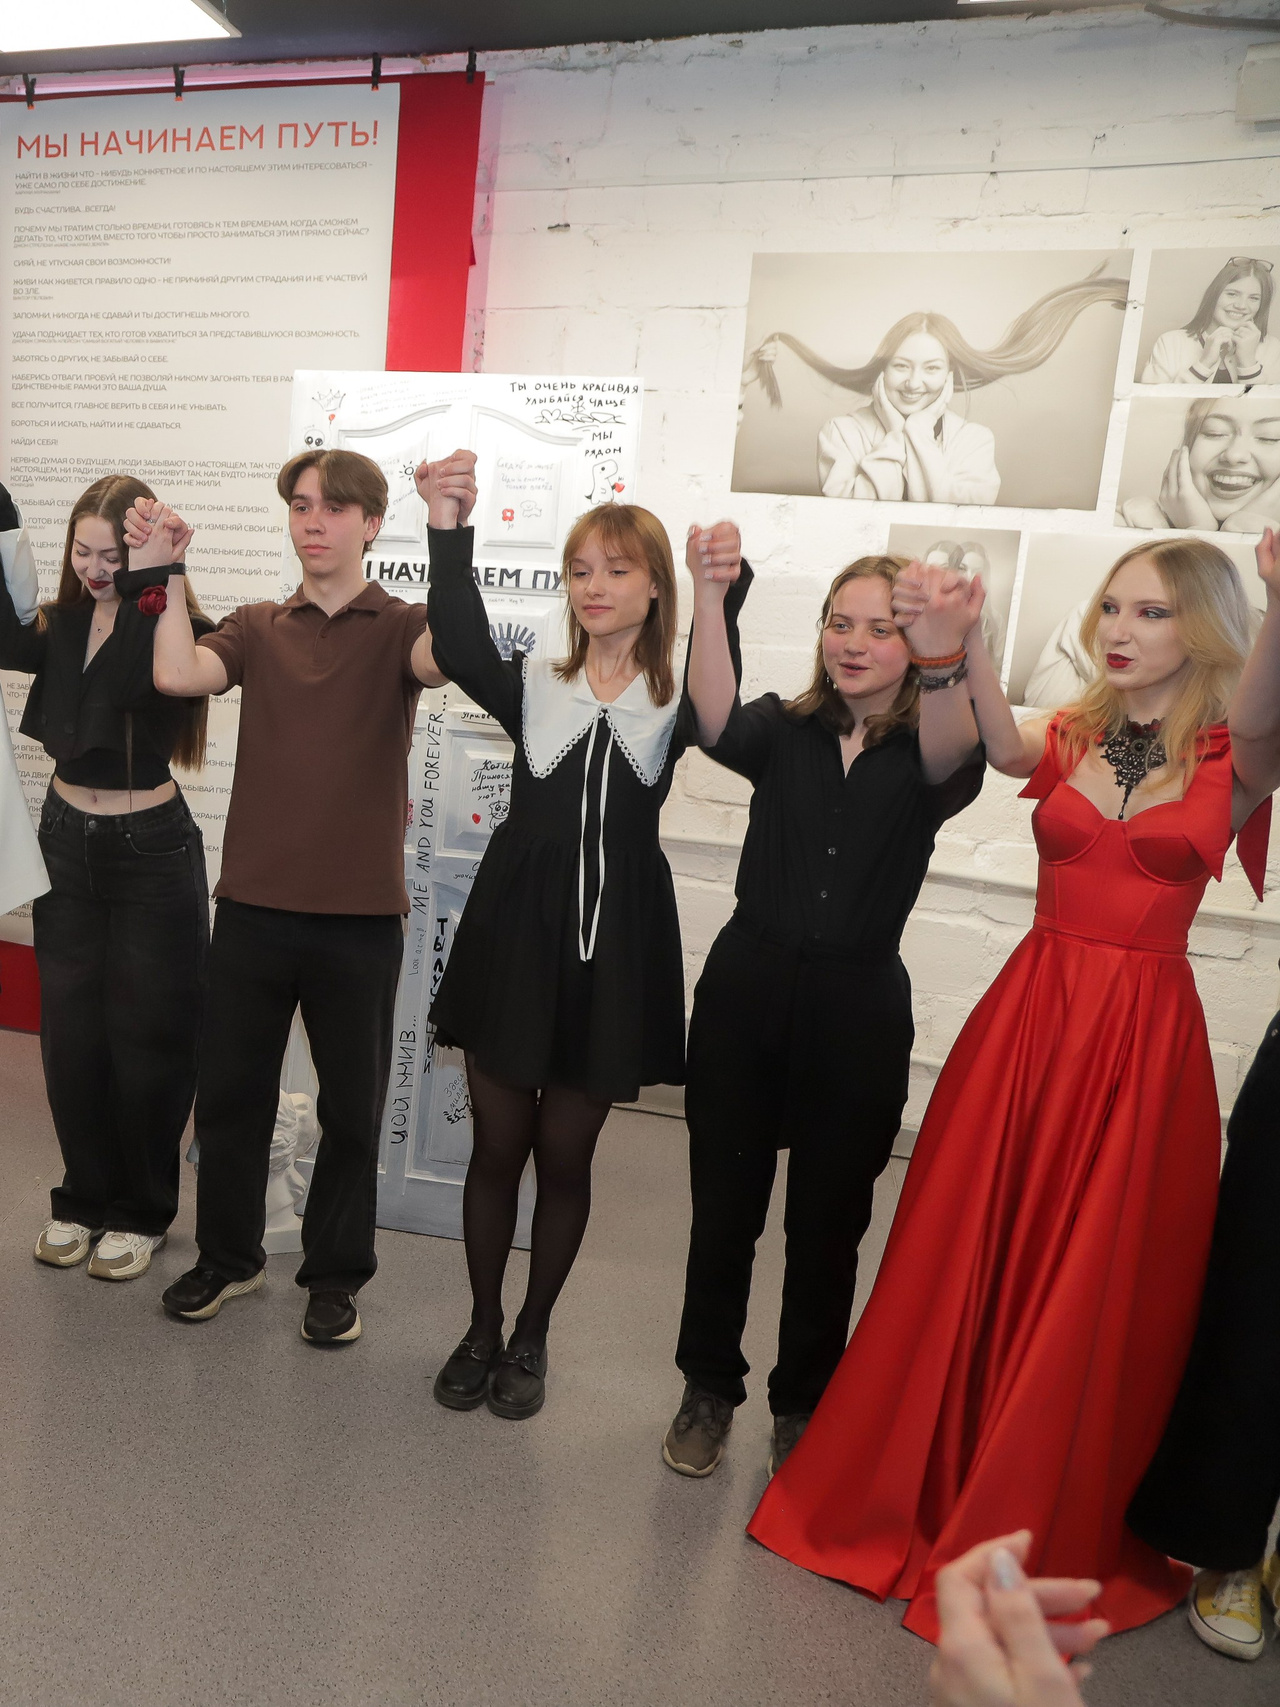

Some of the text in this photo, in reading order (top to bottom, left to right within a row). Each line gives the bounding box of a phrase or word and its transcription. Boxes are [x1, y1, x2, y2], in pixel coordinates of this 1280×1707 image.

[17, 120, 378, 159] МЫ НАЧИНАЕМ ПУТЬ!
[14, 225, 46, 233] ПОЧЕМУ
[63, 224, 94, 232] ТРАТИМ
[94, 223, 131, 231] СТОЛЬКО
[172, 221, 214, 229] ГОТОВЯСЬ
[290, 219, 317, 228] КОГДА
[318, 218, 358, 226] СМОЖЕМ
[14, 235, 43, 243] ДЕЛАТЬ
[136, 232, 156, 240] ТОГО
[186, 231, 219, 239] ПРОСТО
[220, 230, 274, 238] ЗАНИМАТЬСЯ
[332, 227, 370, 236] СЕЙЧАС?
[84, 258, 106, 266] СВОИ
[107, 257, 172, 265] ВОЗМОЖНОСТИ!
[132, 277, 156, 285] ОДНО
[174, 275, 219, 284] ПРИЧИНЯЙ
[220, 276, 254, 284] ДРУГИМ
[254, 276, 304, 284] СТРАДАНИЯ
[325, 272, 368, 281] УЧАСТВУЙ
[52, 312, 89, 320] НИКОГДА
[101, 310, 133, 320] СДАВАЙ
[153, 311, 208, 320] ДОСТИГНЕШЬ
[12, 331, 36, 339] УДАЧА
[37, 331, 86, 339] ПОДЖИДАЕТ
[209, 331, 293, 339] ПРЕДСТАВИВШУЮСЯ
[102, 354, 139, 362] ЗАБЫВАЙ
[129, 373, 173, 382] ПОЗВОЛЯЙ
[12, 383, 72, 392] ЕДИНСТВЕННЫЕ
[510, 382, 639, 394] ТЫ ОЧЕНЬ КРАСИВАЯ
[73, 402, 109, 410] ГЛАВНОЕ
[525, 394, 627, 408] УЛЫБАЙСЯ ЧАЩЕ
[11, 420, 49, 428] БОРОТЬСЯ
[89, 420, 116, 428] НАЙТИ
[10, 437, 36, 447] НАЙДИ
[592, 431, 613, 441] МЫ
[584, 446, 622, 459] РЯДОМ
[379, 560, 563, 590] НАЧАЕМ ПУ
[482, 759, 512, 771] Коти
[471, 768, 512, 786] Принося
[419, 797, 434, 829] YOU
[417, 836, 431, 873] AND
[412, 881, 429, 915] ME
[433, 918, 448, 952] ТЫ
